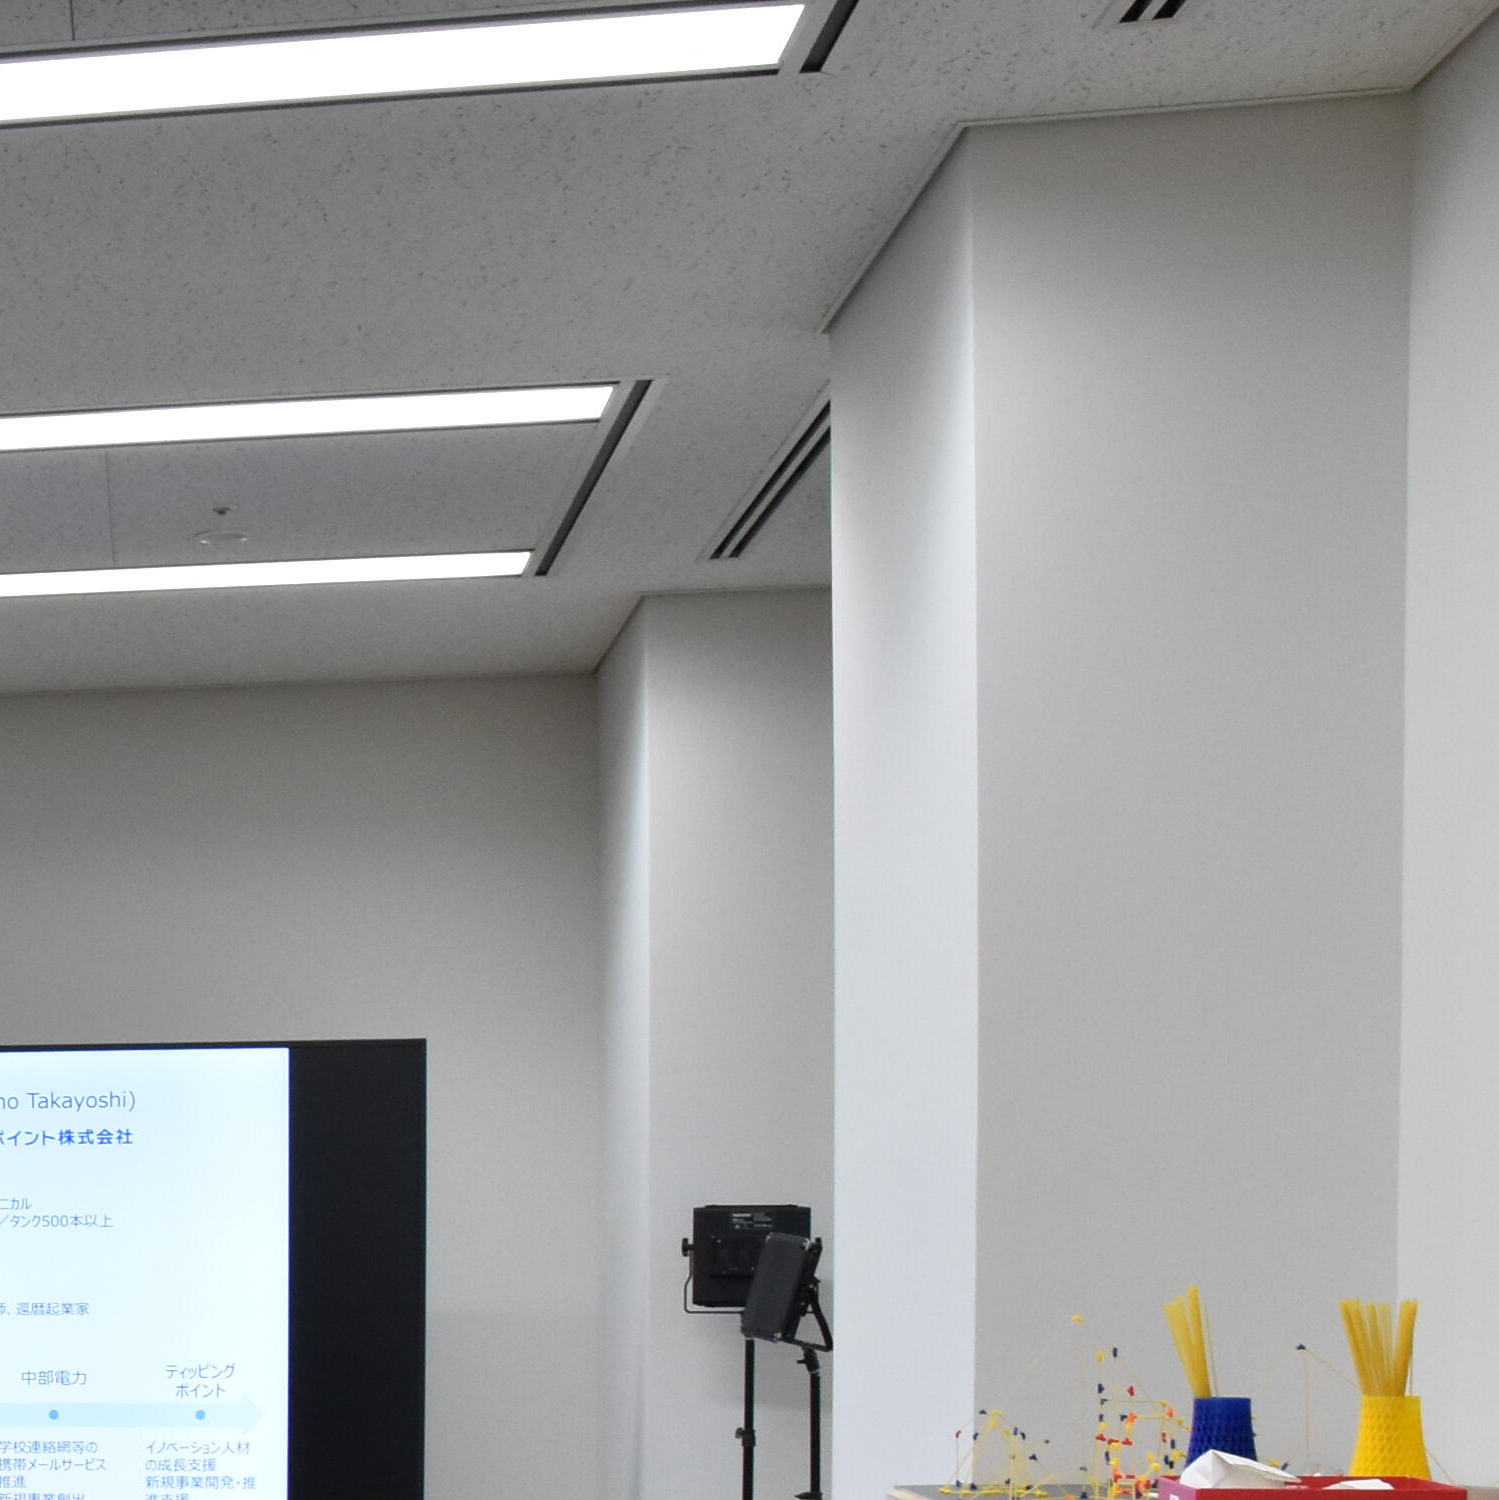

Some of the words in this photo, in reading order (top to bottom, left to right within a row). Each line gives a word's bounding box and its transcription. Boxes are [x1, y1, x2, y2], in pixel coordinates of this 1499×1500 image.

[21, 1370, 87, 1386] 中部電力
[165, 1362, 236, 1380] ティッピング
[146, 1441, 251, 1455] イノベーション人材
[145, 1458, 217, 1472] の成長支援
[146, 1476, 257, 1490] 新規事業開発・推
